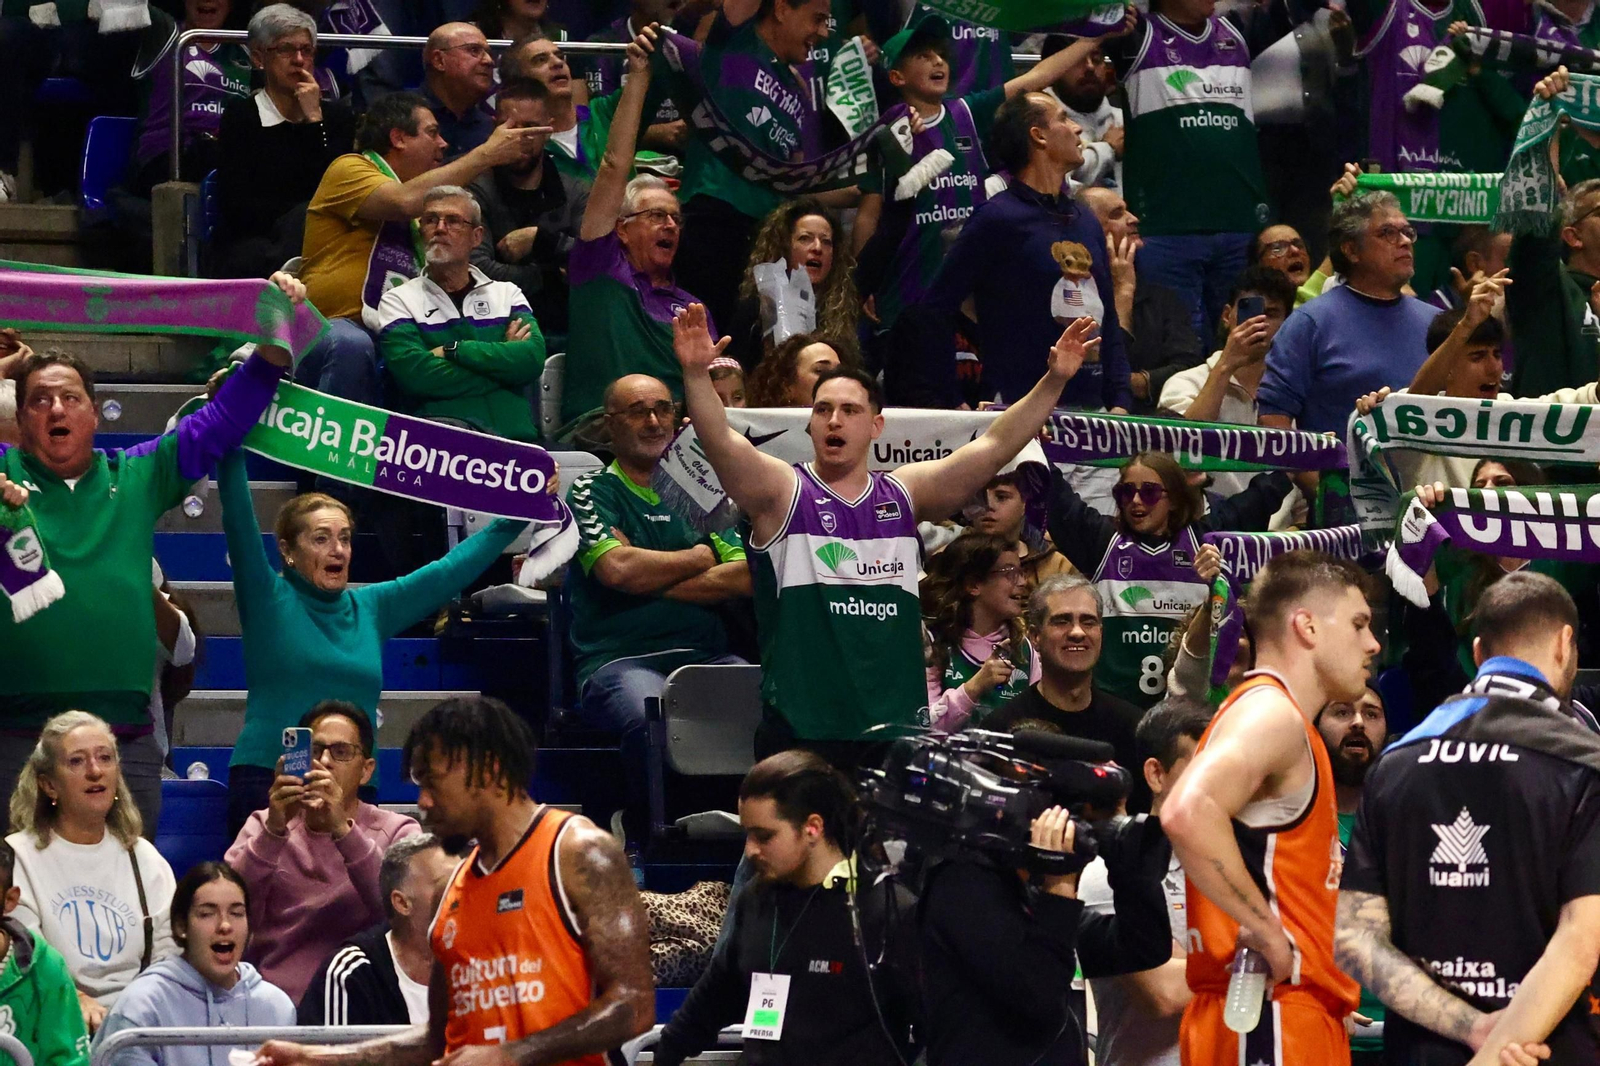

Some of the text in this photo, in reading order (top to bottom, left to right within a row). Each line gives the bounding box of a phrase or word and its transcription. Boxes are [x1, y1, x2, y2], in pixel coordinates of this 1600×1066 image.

[1202, 82, 1243, 97] Unicaja
[1410, 188, 1488, 216] UNICAJA
[349, 418, 546, 494] Baloncesto
[856, 558, 904, 576] Unicaja
[1139, 655, 1164, 695] 8
[1428, 866, 1490, 887] luanvi
[96, 889, 137, 927] STUDIO
[59, 900, 127, 961] CLUB
[519, 957, 542, 974] del
[1430, 957, 1496, 978] caixa
[762, 998, 774, 1008] PG
[750, 1028, 774, 1037] PRENSA
